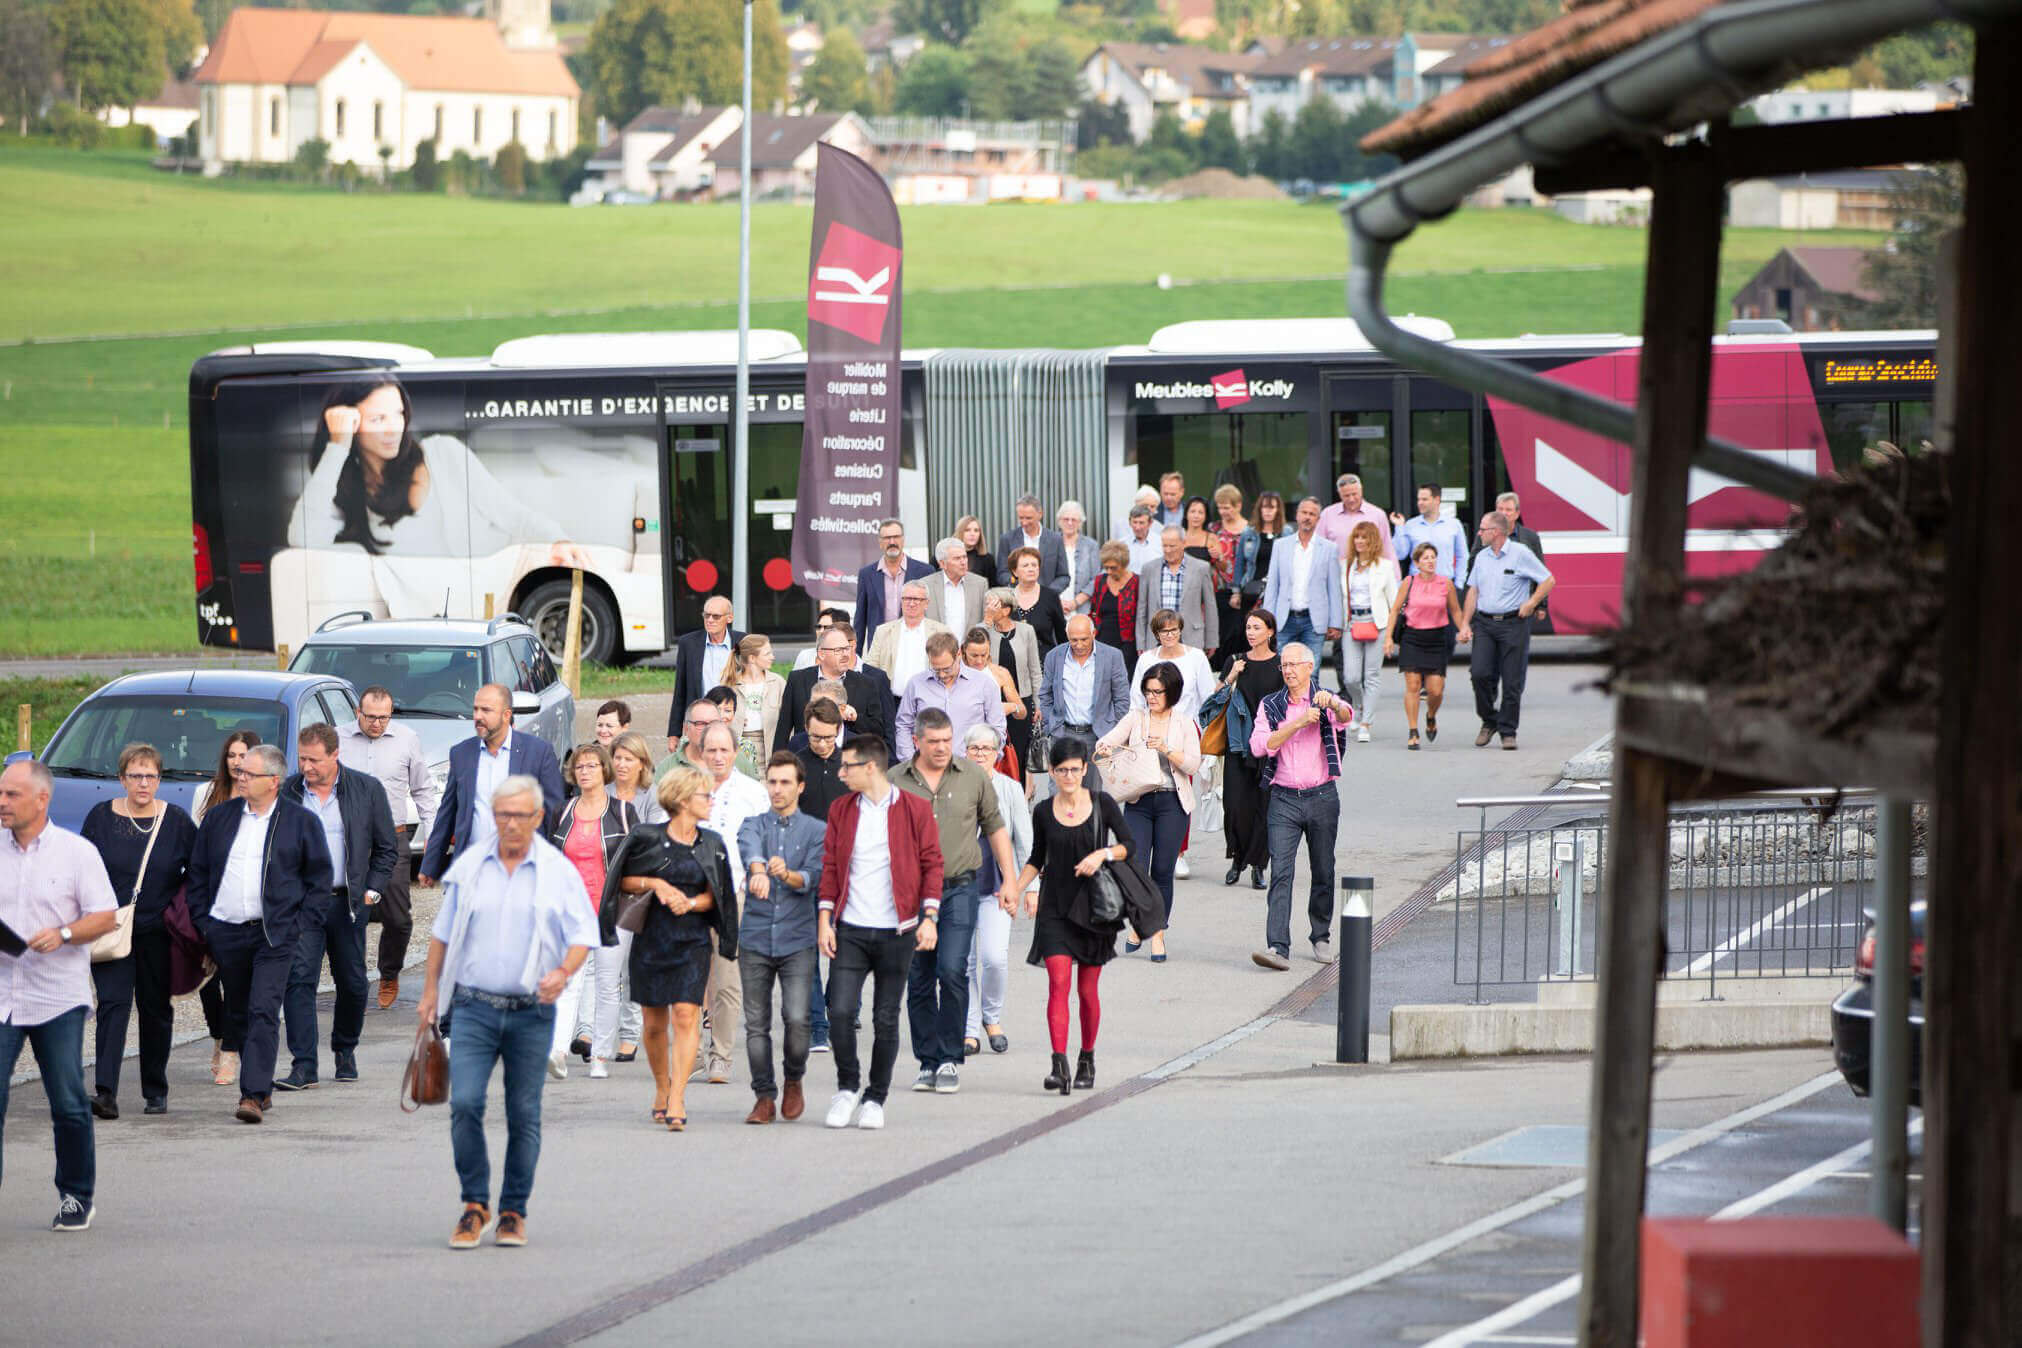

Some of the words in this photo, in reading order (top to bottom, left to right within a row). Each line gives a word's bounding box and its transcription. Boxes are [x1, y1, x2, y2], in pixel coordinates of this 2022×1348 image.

[1135, 381, 1214, 398] Meubles
[1250, 379, 1294, 399] Kolly
[777, 394, 805, 411] DE
